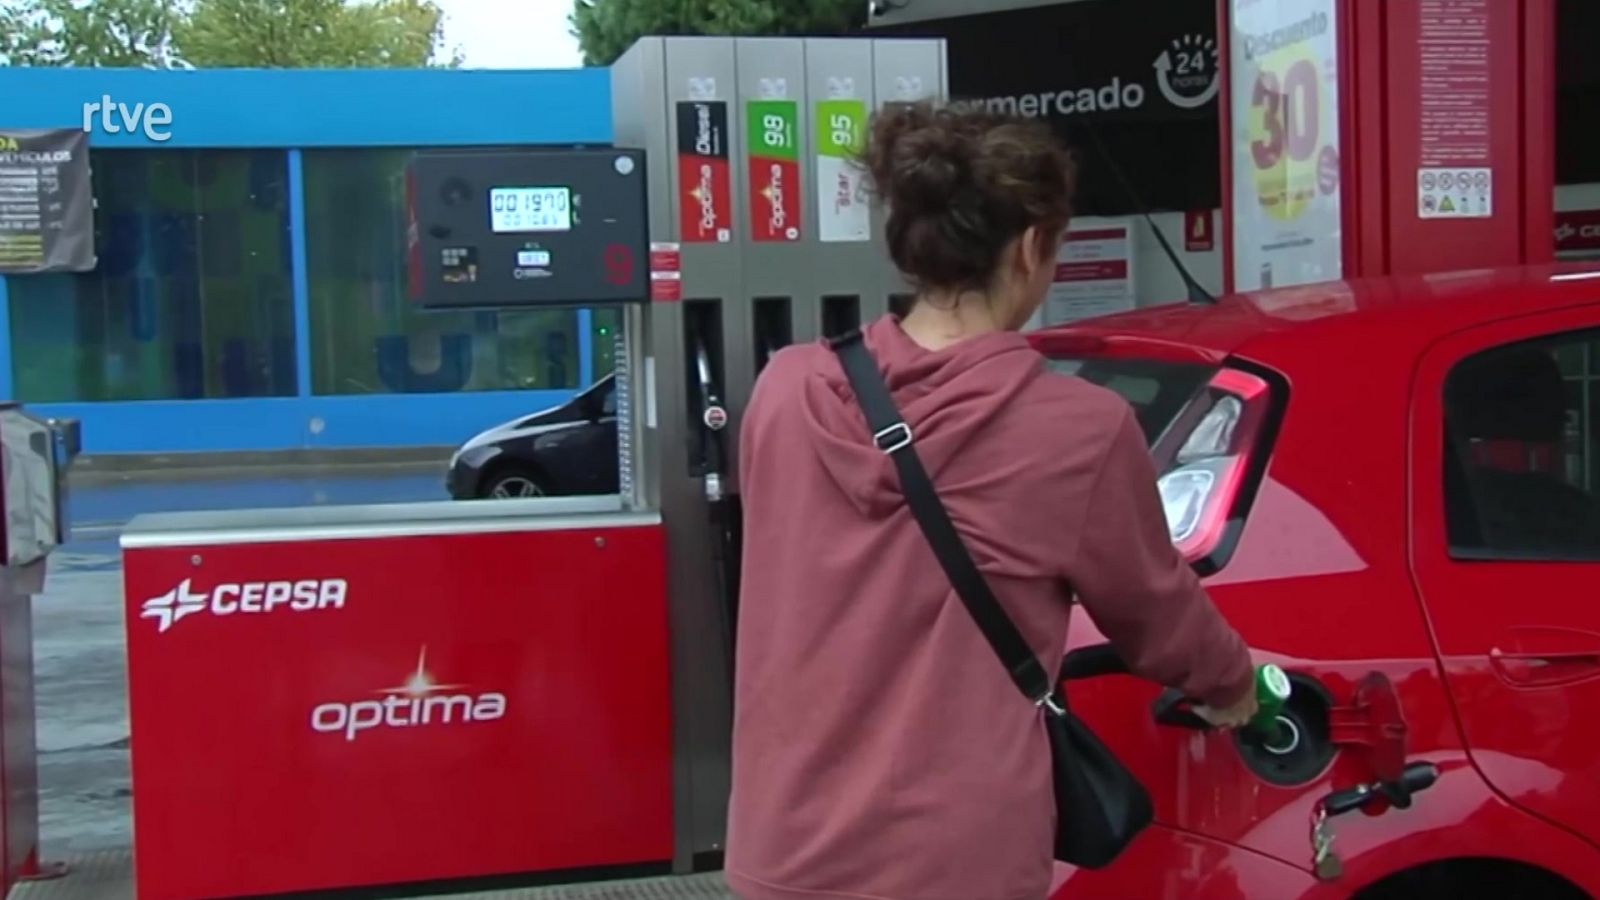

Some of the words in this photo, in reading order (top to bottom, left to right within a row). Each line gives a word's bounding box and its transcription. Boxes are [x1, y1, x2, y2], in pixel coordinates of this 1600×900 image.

[1175, 51, 1205, 75] 24
[950, 77, 1145, 117] ermercado
[1251, 59, 1320, 170] 30
[695, 103, 712, 155] Diesel
[763, 114, 785, 147] 98
[830, 114, 852, 146] 95
[700, 163, 718, 230] optima
[769, 163, 787, 229] optima
[210, 577, 348, 615] CEPSA
[311, 690, 507, 741] optima
